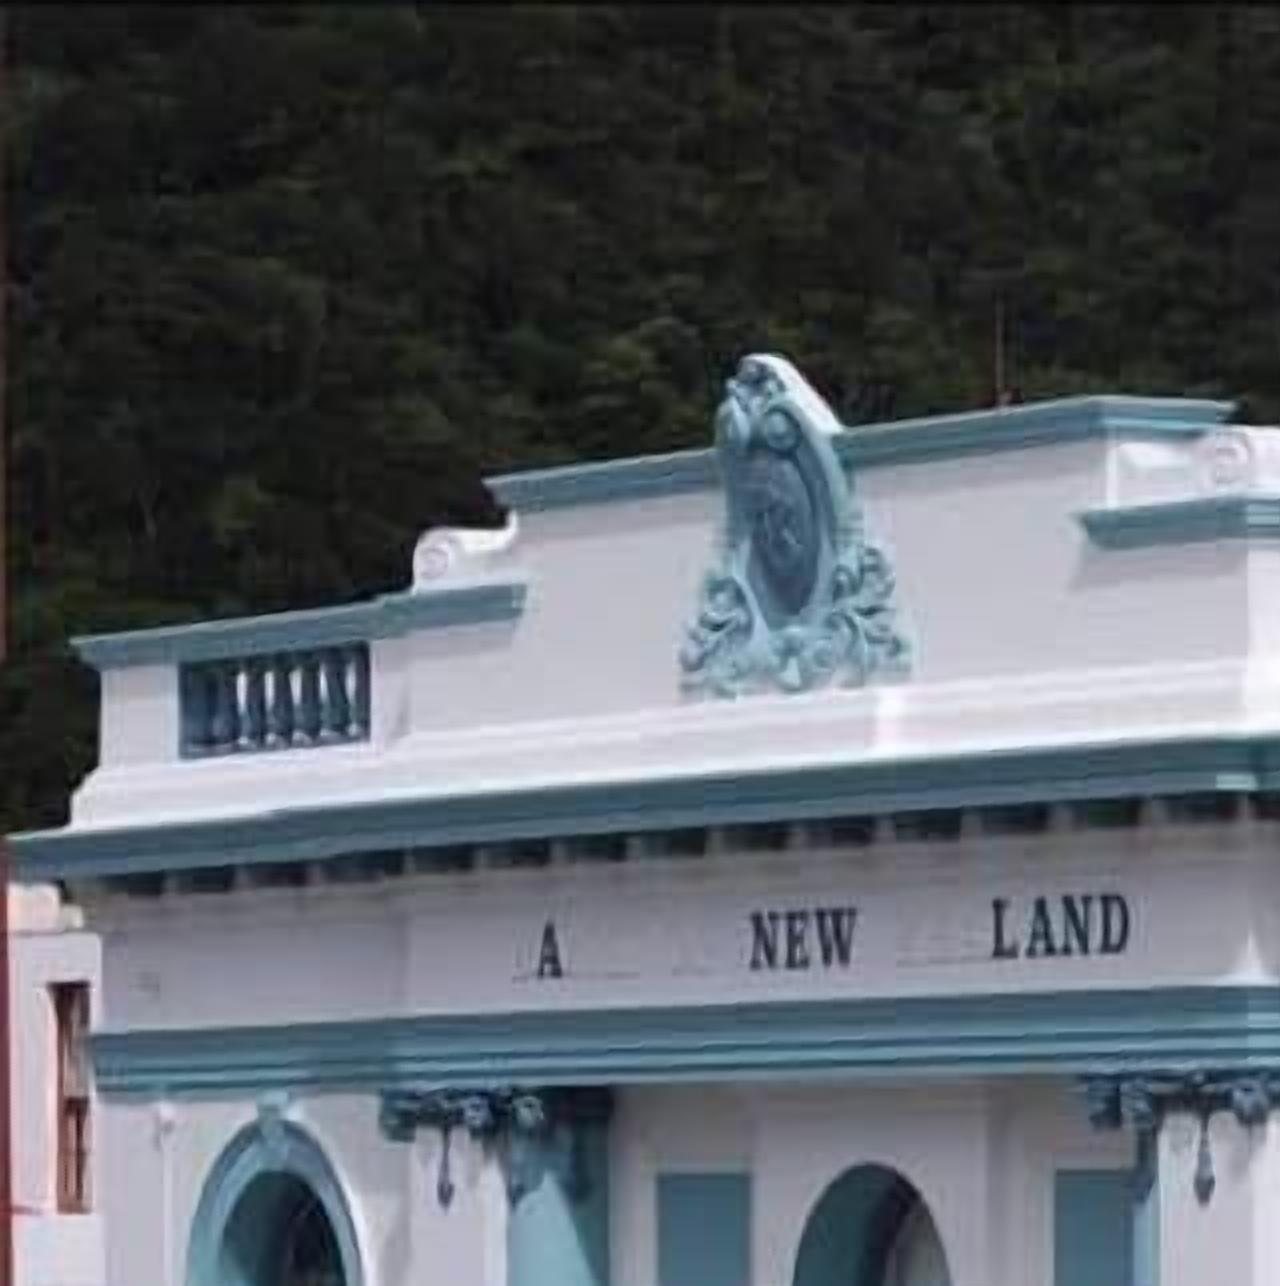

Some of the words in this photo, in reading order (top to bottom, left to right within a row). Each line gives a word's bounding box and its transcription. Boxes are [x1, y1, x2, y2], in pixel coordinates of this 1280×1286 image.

[537, 919, 563, 979] A
[748, 907, 858, 970] NEW
[991, 894, 1131, 959] LAND
